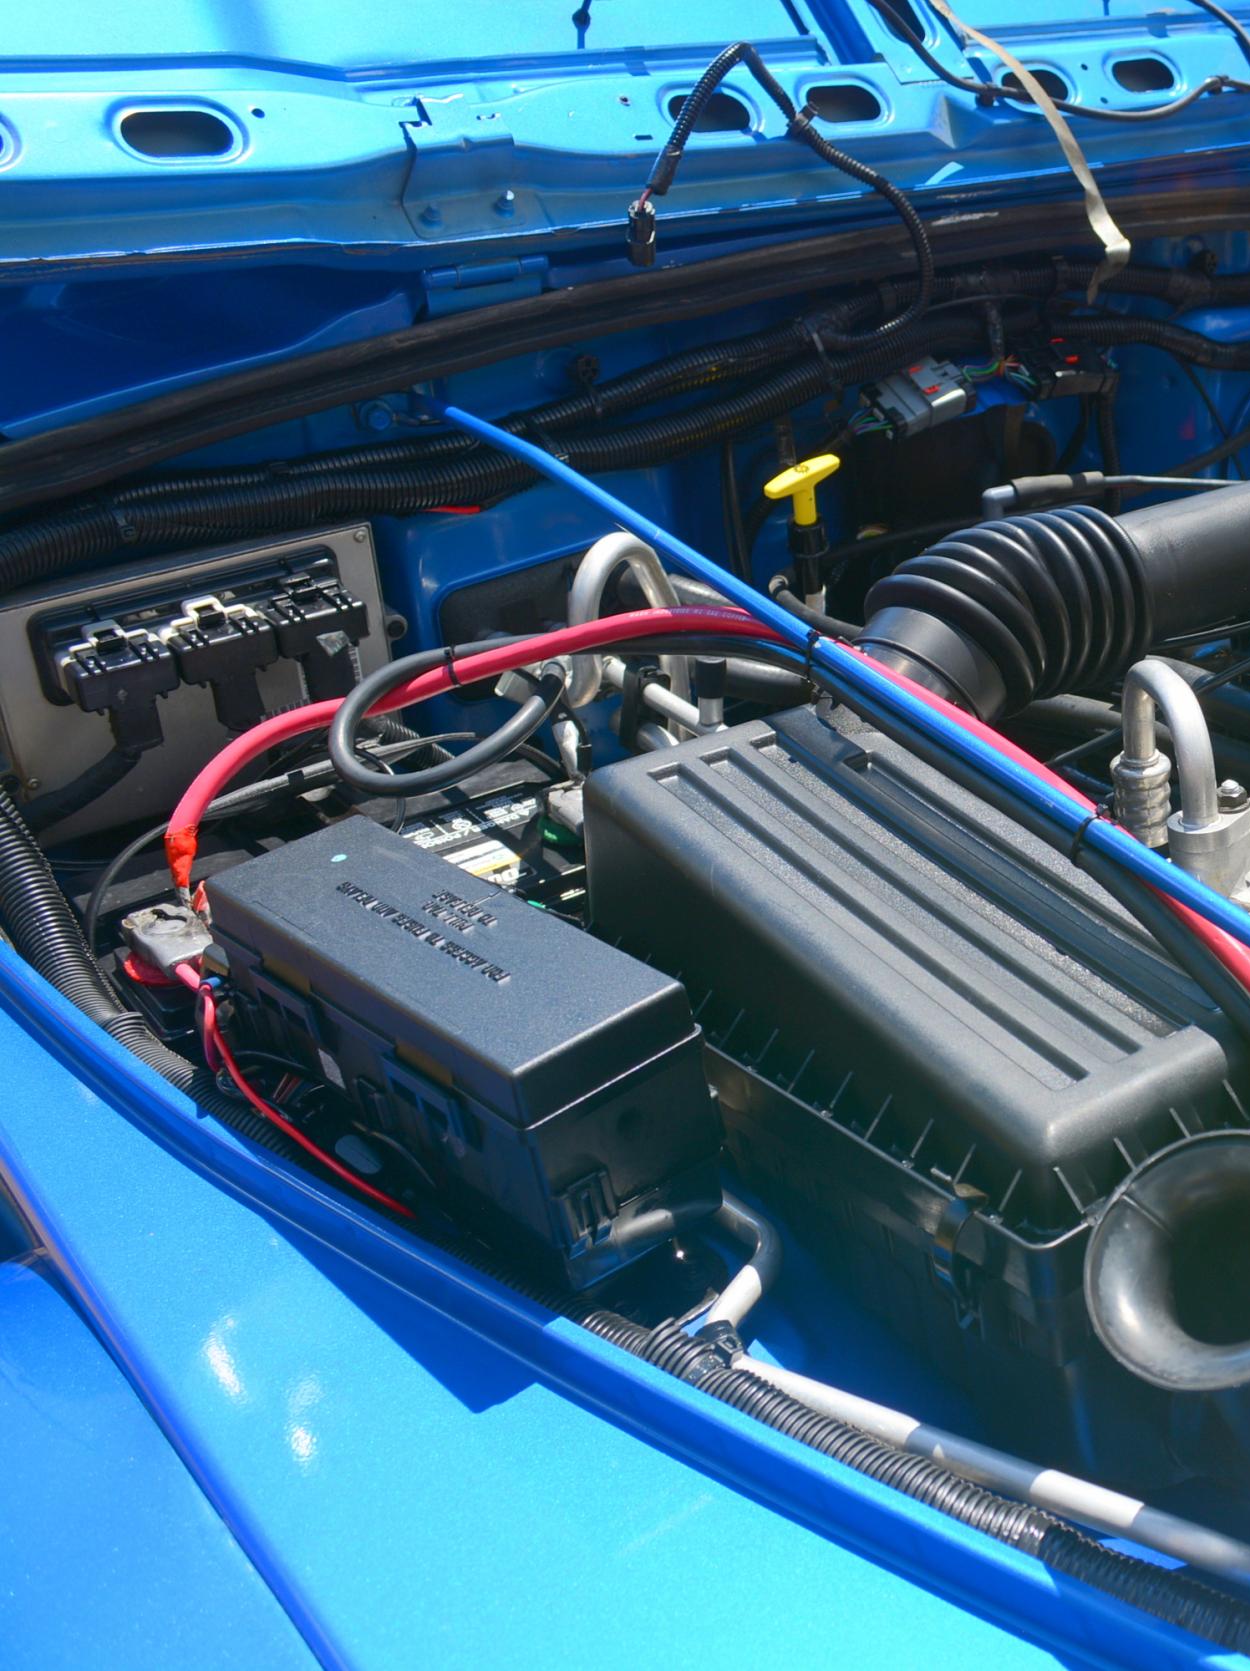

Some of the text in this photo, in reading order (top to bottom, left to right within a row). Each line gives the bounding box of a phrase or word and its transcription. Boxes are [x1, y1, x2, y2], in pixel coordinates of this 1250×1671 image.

[392, 914, 431, 940] FUSES
[477, 914, 497, 929] TO
[425, 932, 446, 948] TO
[440, 941, 487, 970] ACCESS
